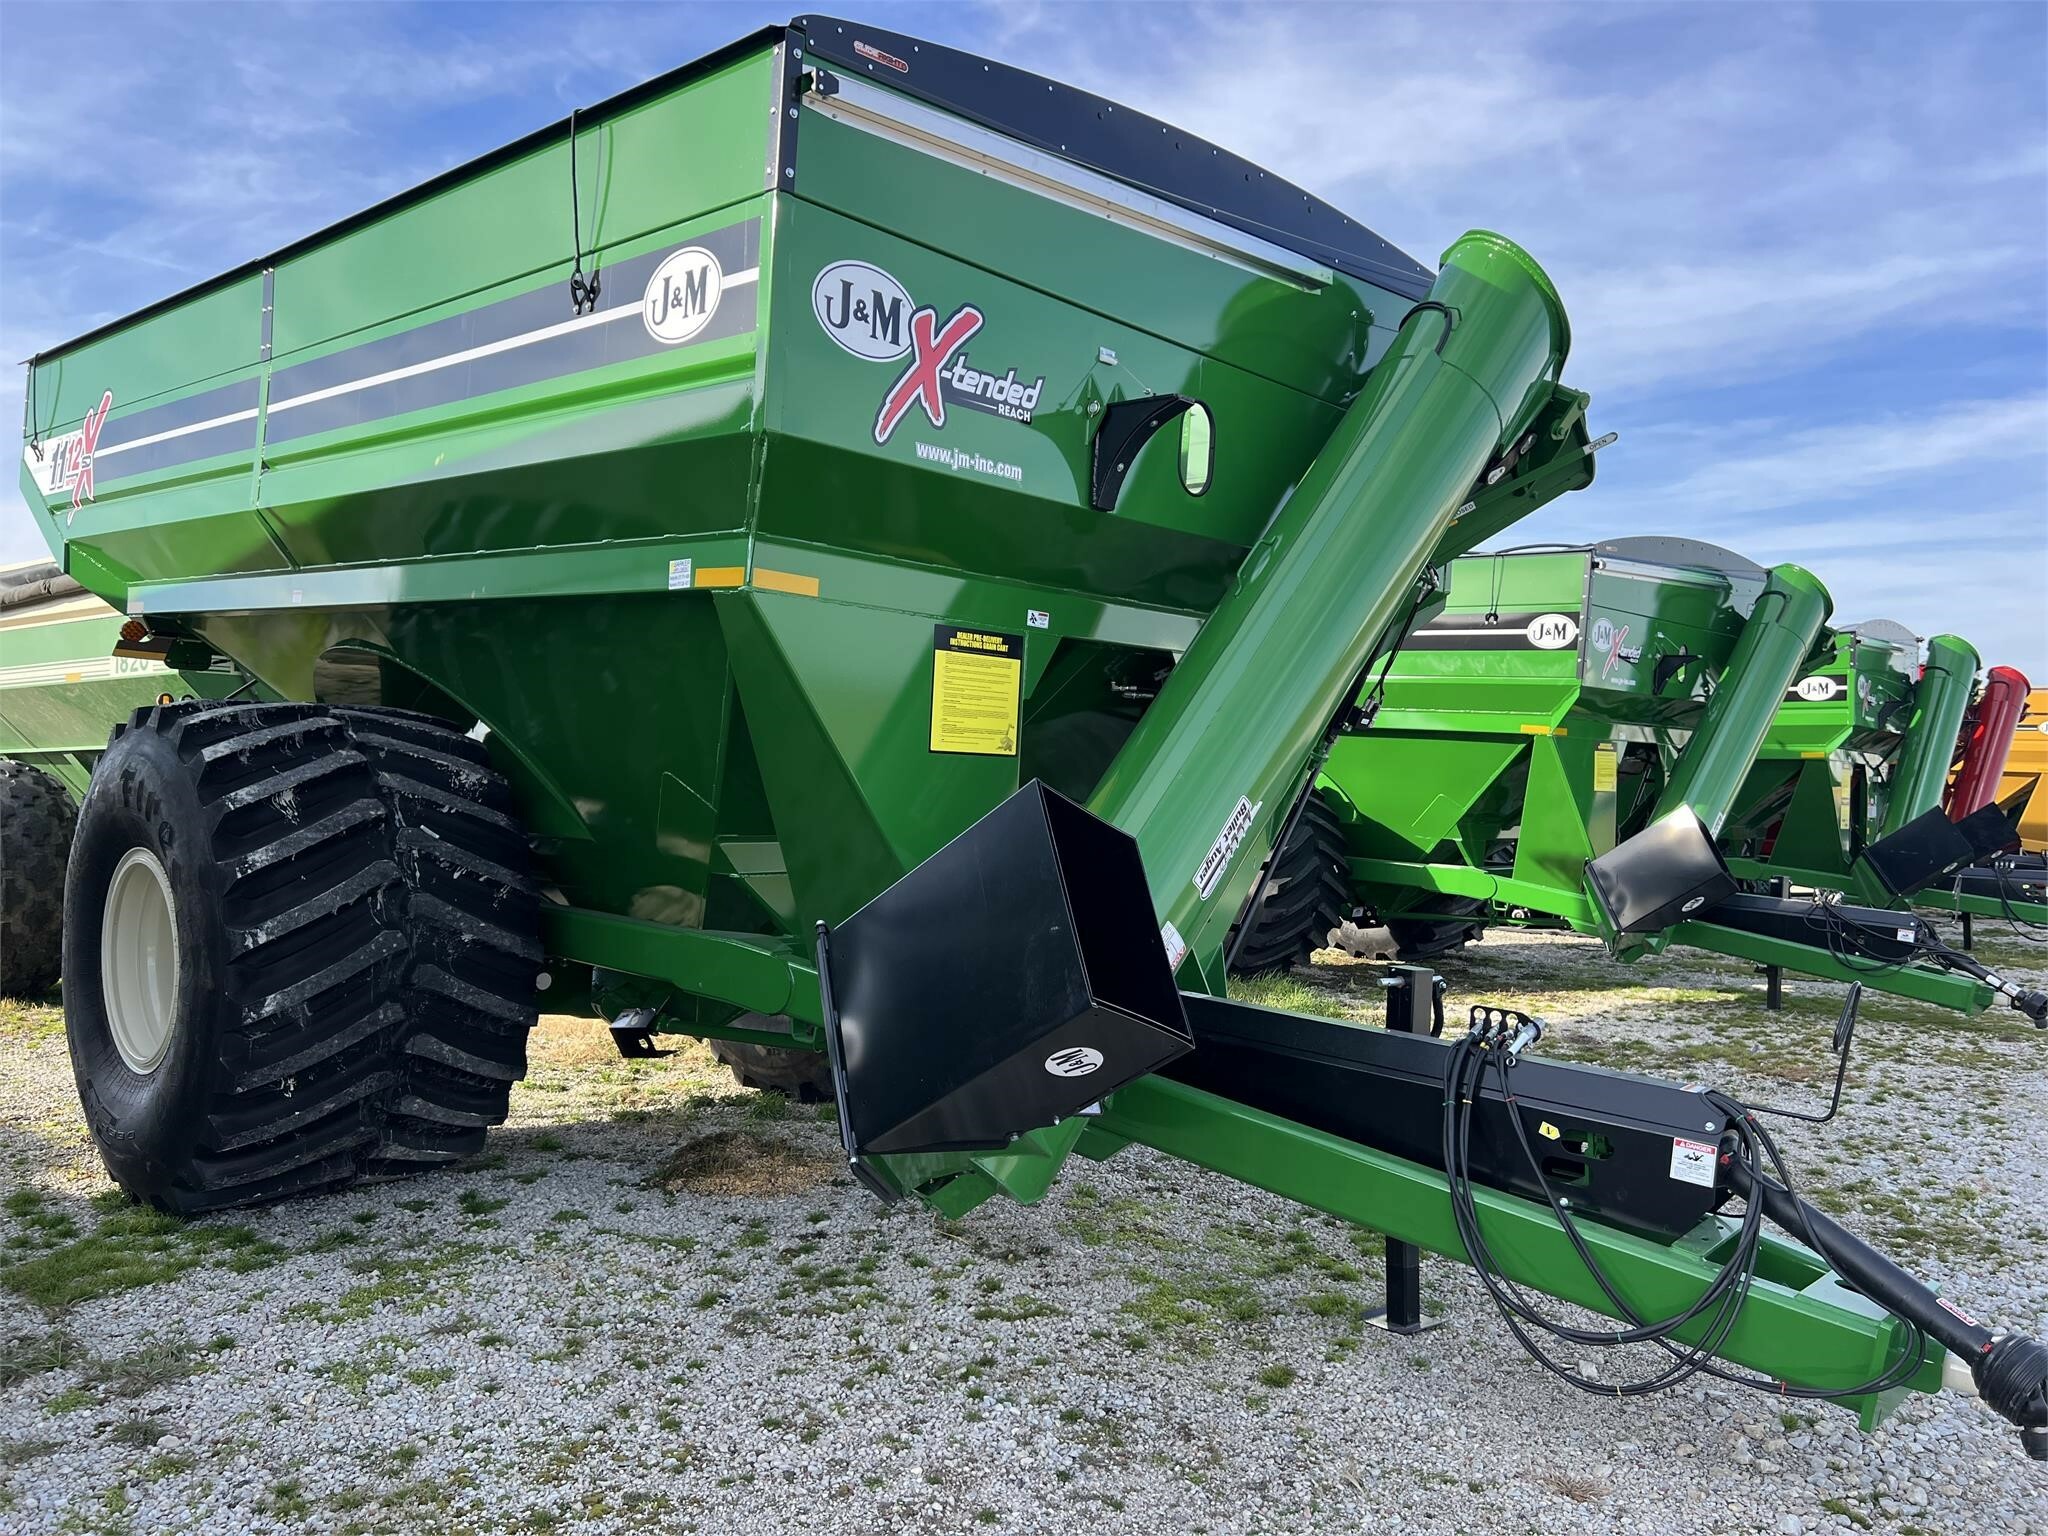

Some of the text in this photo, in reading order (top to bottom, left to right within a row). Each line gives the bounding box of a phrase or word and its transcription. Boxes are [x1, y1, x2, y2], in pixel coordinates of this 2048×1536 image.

[651, 264, 709, 326] J&M
[824, 278, 903, 347] J&M
[998, 403, 1031, 422] REACH
[1589, 438, 1608, 450] OPEN
[915, 441, 1023, 481] www.jm-inc.com
[1532, 623, 1567, 640] J&M
[1802, 682, 1829, 696] J&M
[1199, 802, 1247, 884] Bullet Auger
[1050, 1048, 1098, 1074] J&M
[1686, 1142, 1711, 1152] DANGER
